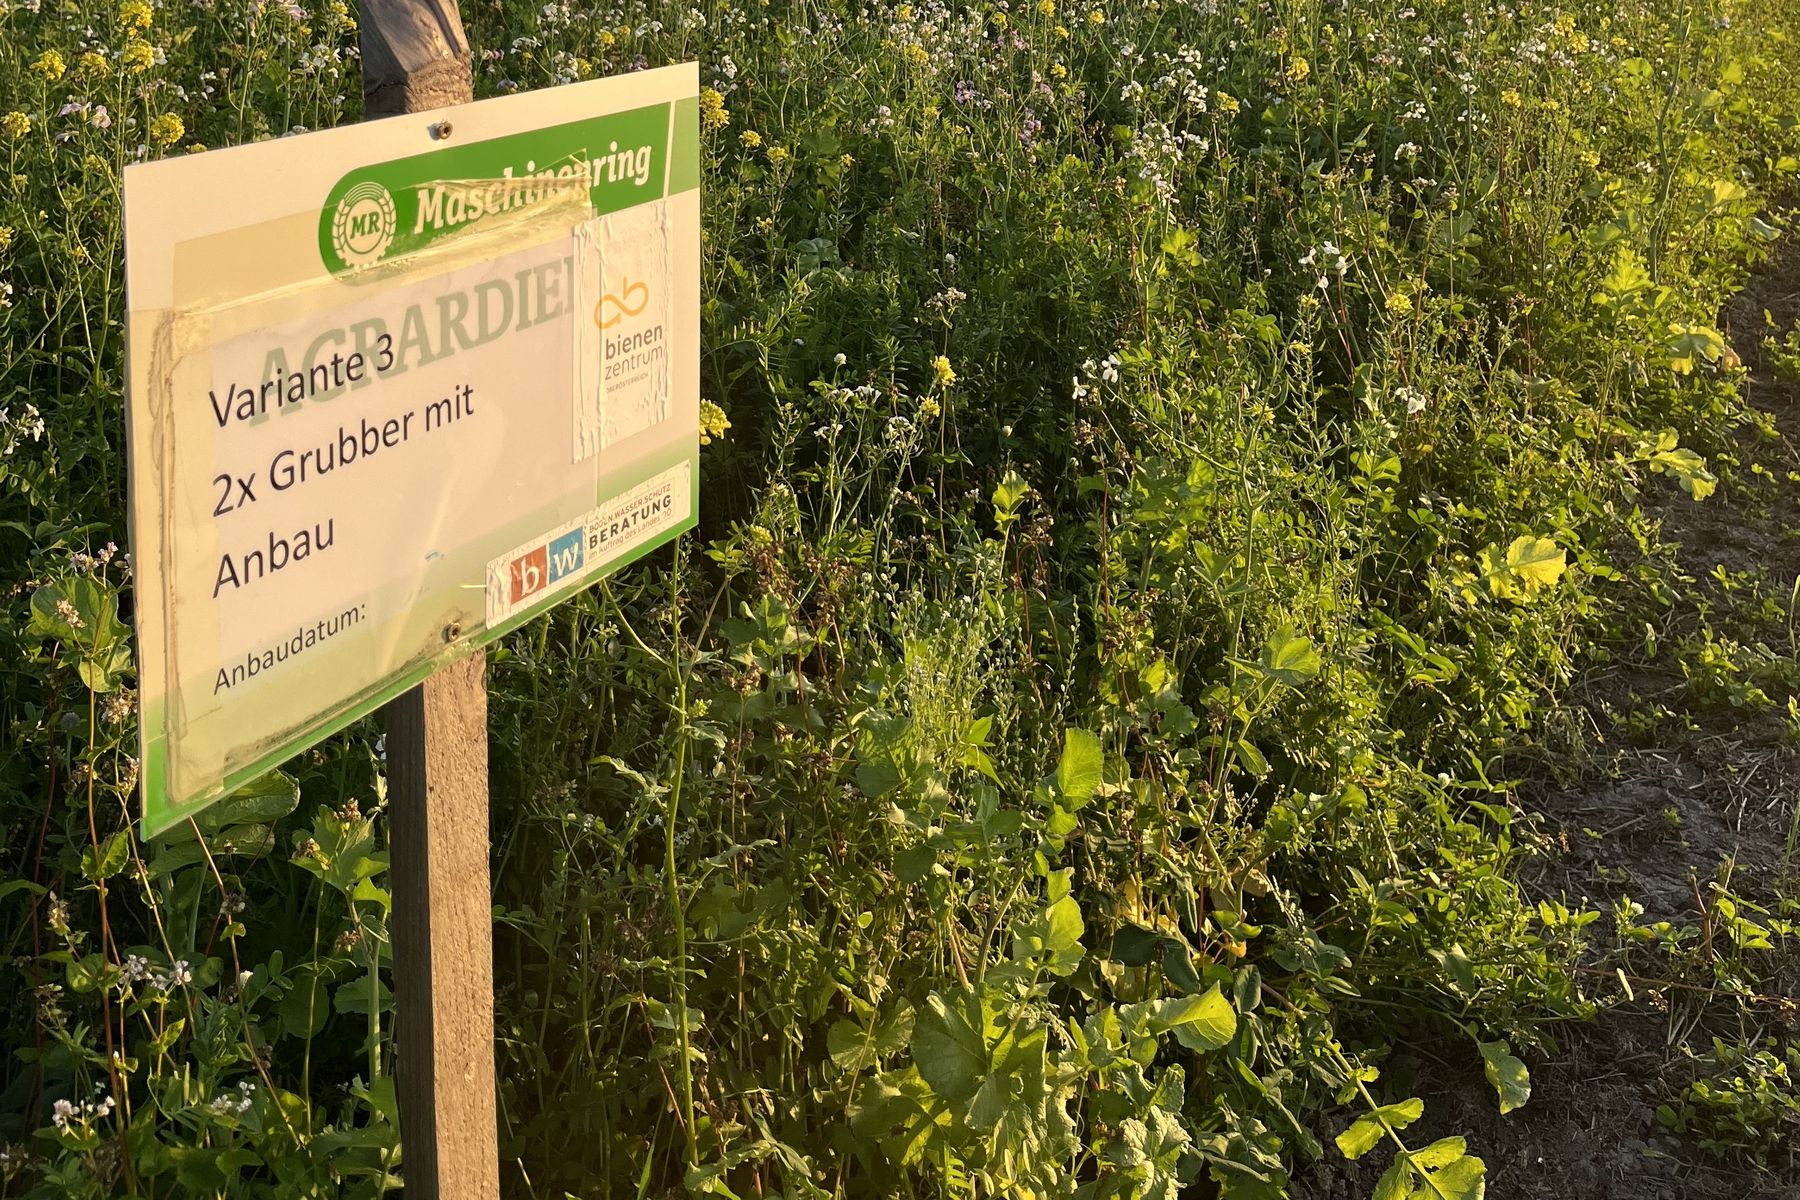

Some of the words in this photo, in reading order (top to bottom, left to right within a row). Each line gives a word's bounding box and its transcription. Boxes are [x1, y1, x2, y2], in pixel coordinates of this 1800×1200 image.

[350, 211, 381, 240] MR
[413, 141, 652, 234] Maschinenring
[208, 350, 364, 428] Variante
[376, 333, 394, 372] 3
[604, 345, 663, 381] zentrum
[605, 325, 663, 361] bienen
[211, 472, 256, 518] 2x
[269, 409, 414, 492] Grubber
[424, 384, 475, 432] mit
[212, 518, 335, 599] Anbau
[589, 495, 672, 550] BERATUNG
[213, 603, 366, 697] Anbaudatum:
